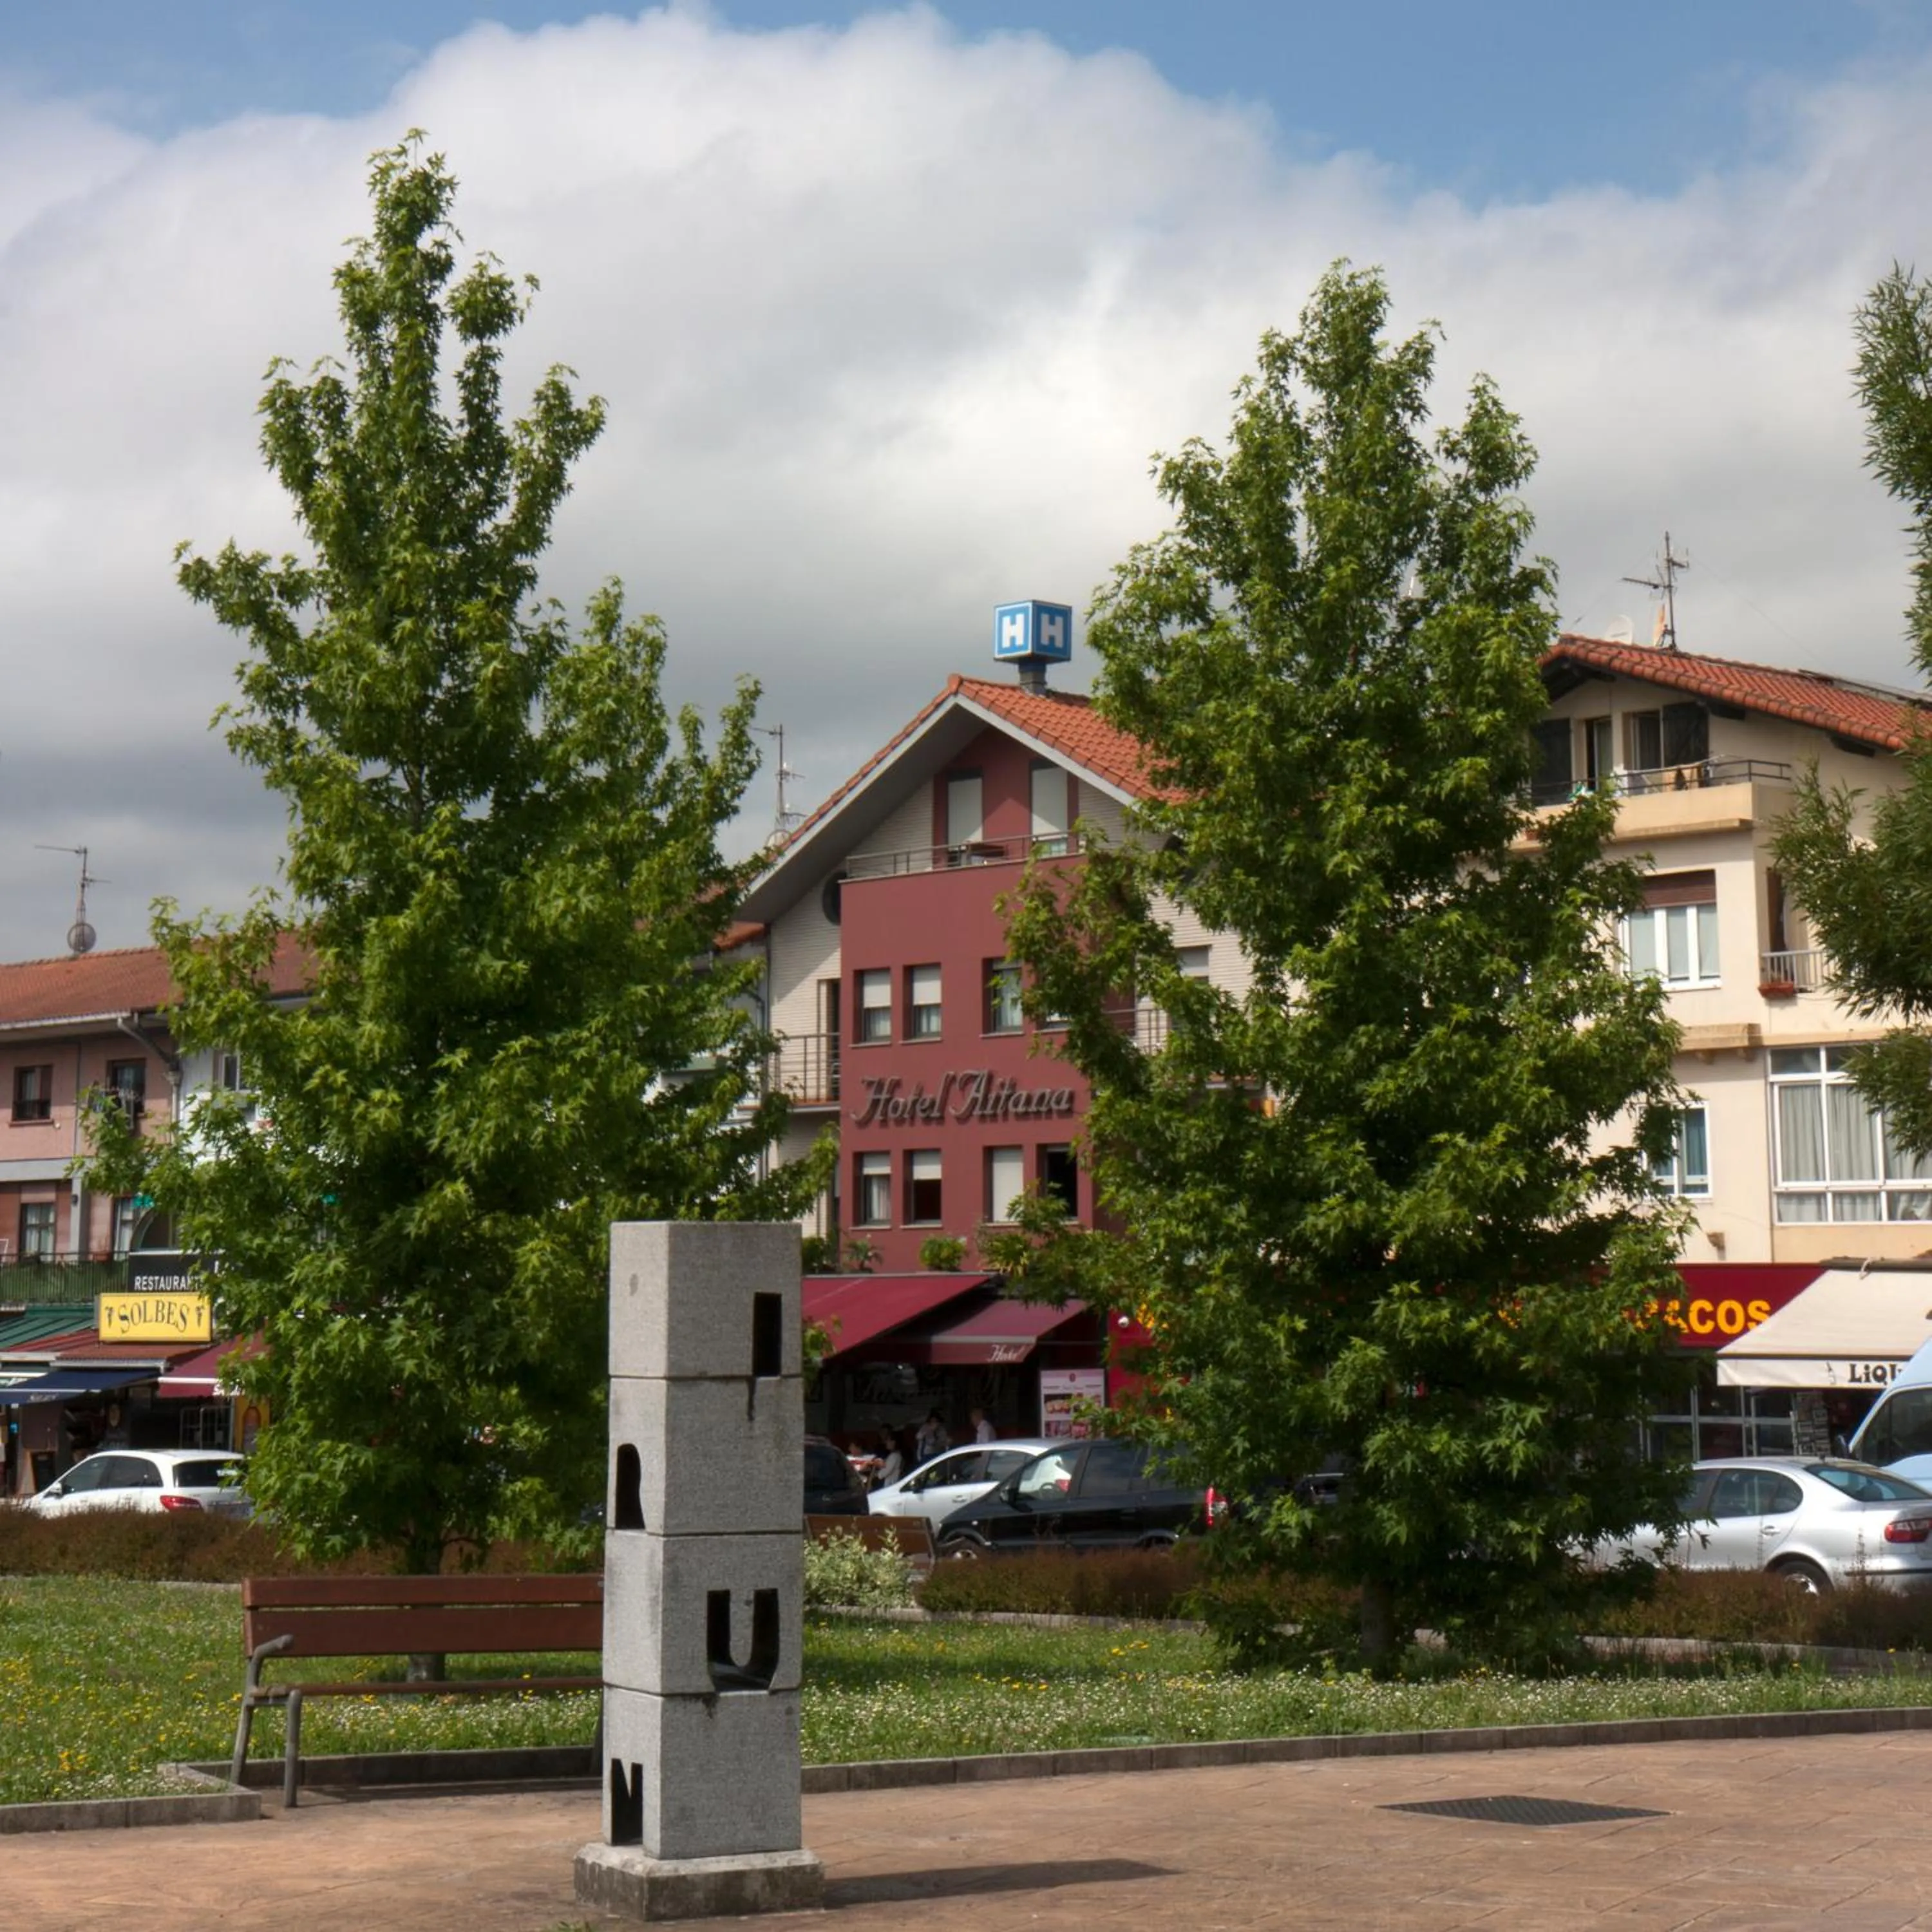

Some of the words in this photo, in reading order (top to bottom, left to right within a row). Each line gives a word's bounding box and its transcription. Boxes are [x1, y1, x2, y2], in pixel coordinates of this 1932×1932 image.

[850, 1071, 956, 1124] Hotel
[949, 1069, 1075, 1119] Aitana
[118, 1299, 190, 1334] SOLBES
